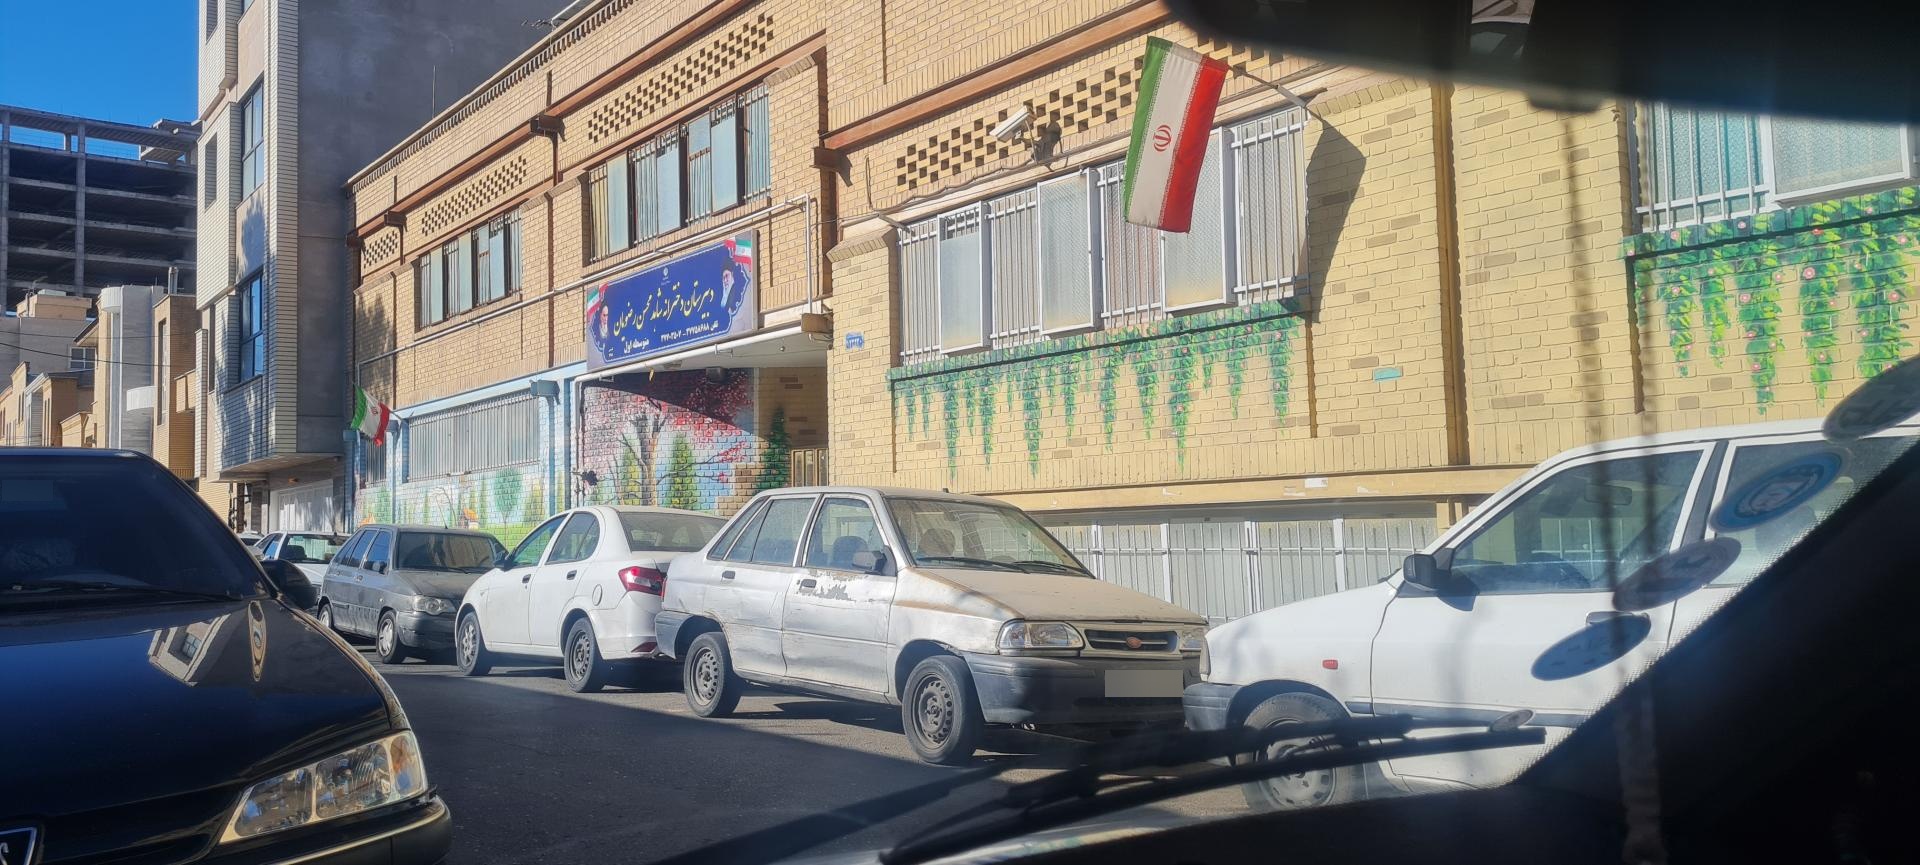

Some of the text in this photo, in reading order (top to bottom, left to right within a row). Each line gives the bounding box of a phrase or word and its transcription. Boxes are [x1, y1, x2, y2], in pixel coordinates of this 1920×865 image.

[636, 294, 652, 330] محسن
[662, 281, 684, 320] دخترانه
[683, 280, 714, 320] دبیرستان
[623, 340, 633, 354] اول
[632, 338, 649, 350] متوسطه
